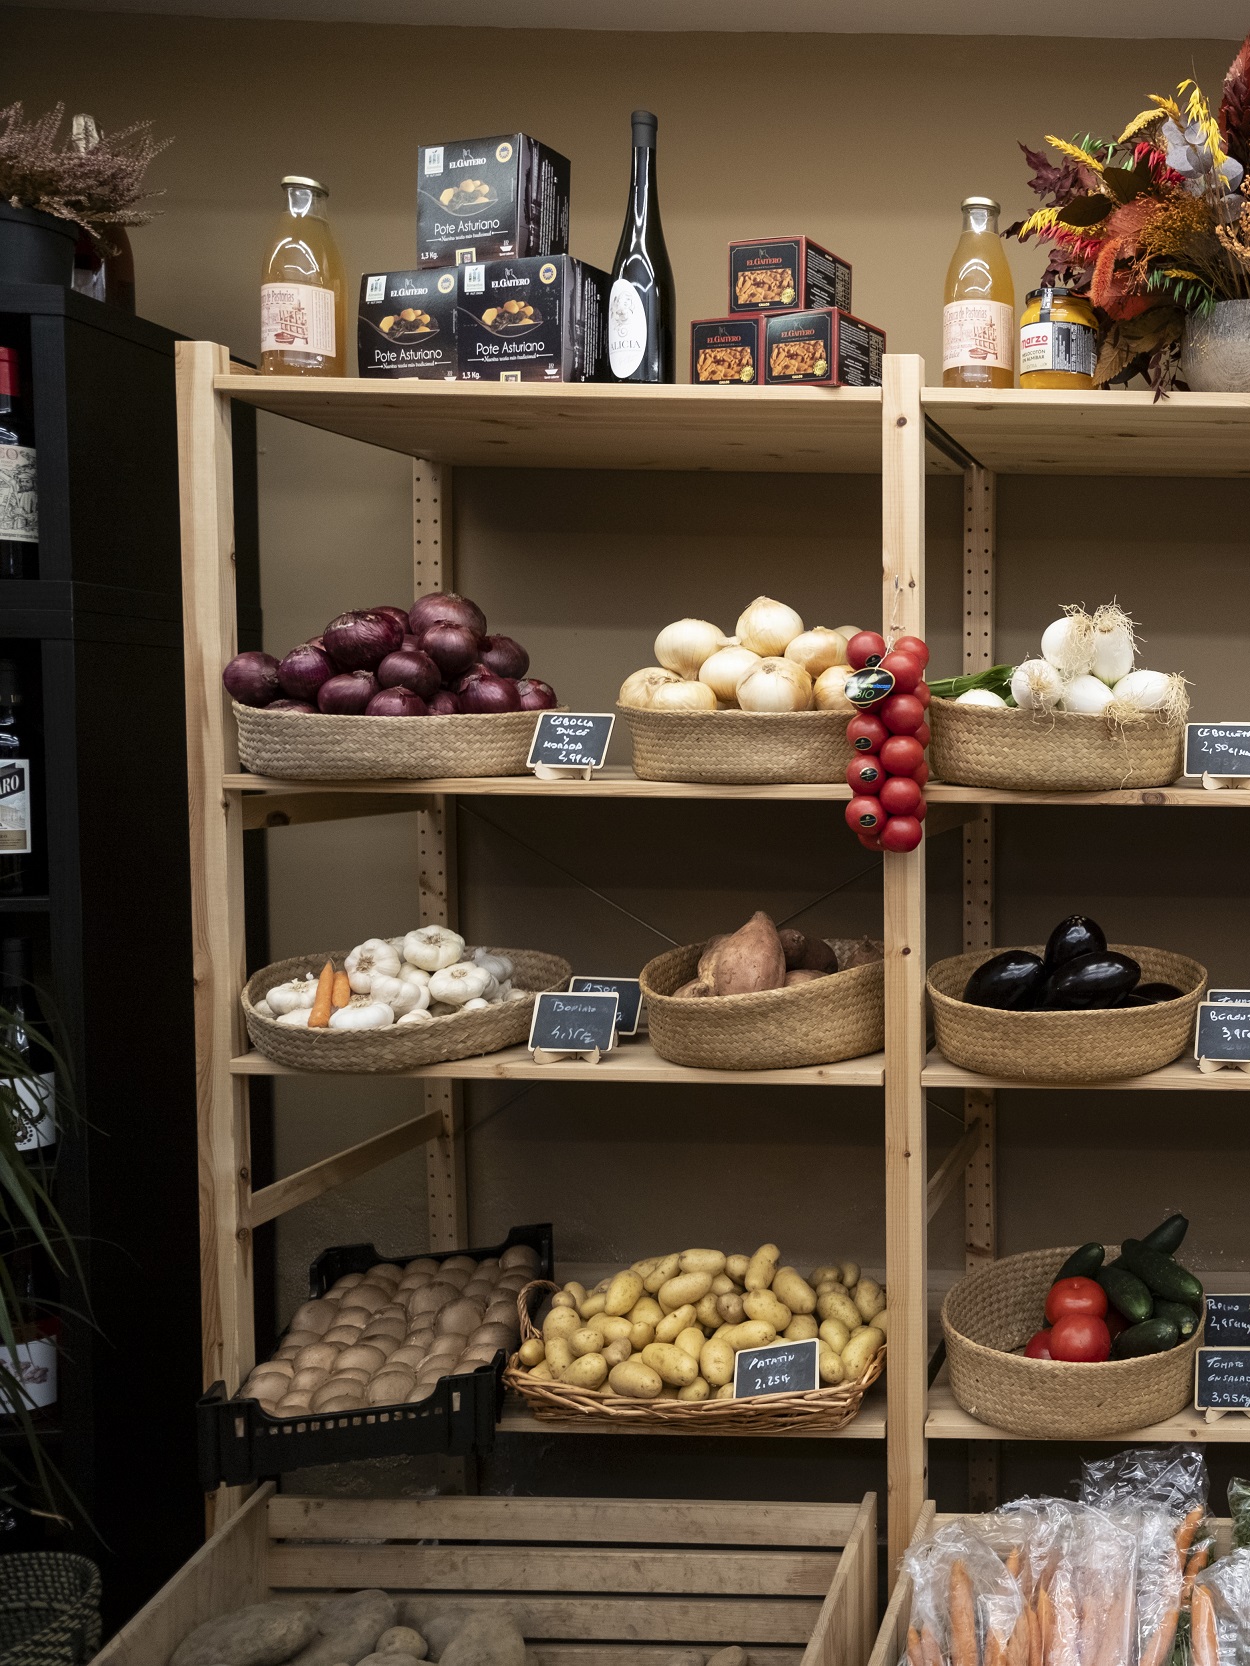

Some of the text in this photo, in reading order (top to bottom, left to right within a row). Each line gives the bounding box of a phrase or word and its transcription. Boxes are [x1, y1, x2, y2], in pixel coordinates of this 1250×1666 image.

[435, 220, 499, 235] Pote Asturiano
[421, 252, 429, 260] 1,3
[1022, 335, 1048, 349] marzo
[477, 341, 545, 355] Pote Asturiano
[375, 349, 442, 362] Pote Asturiano
[856, 690, 875, 698] BIO
[550, 716, 594, 727] CEBOLLA
[556, 727, 590, 736] DULCE
[543, 741, 583, 750] MORADA
[1207, 1357, 1244, 1369] TOMATE
